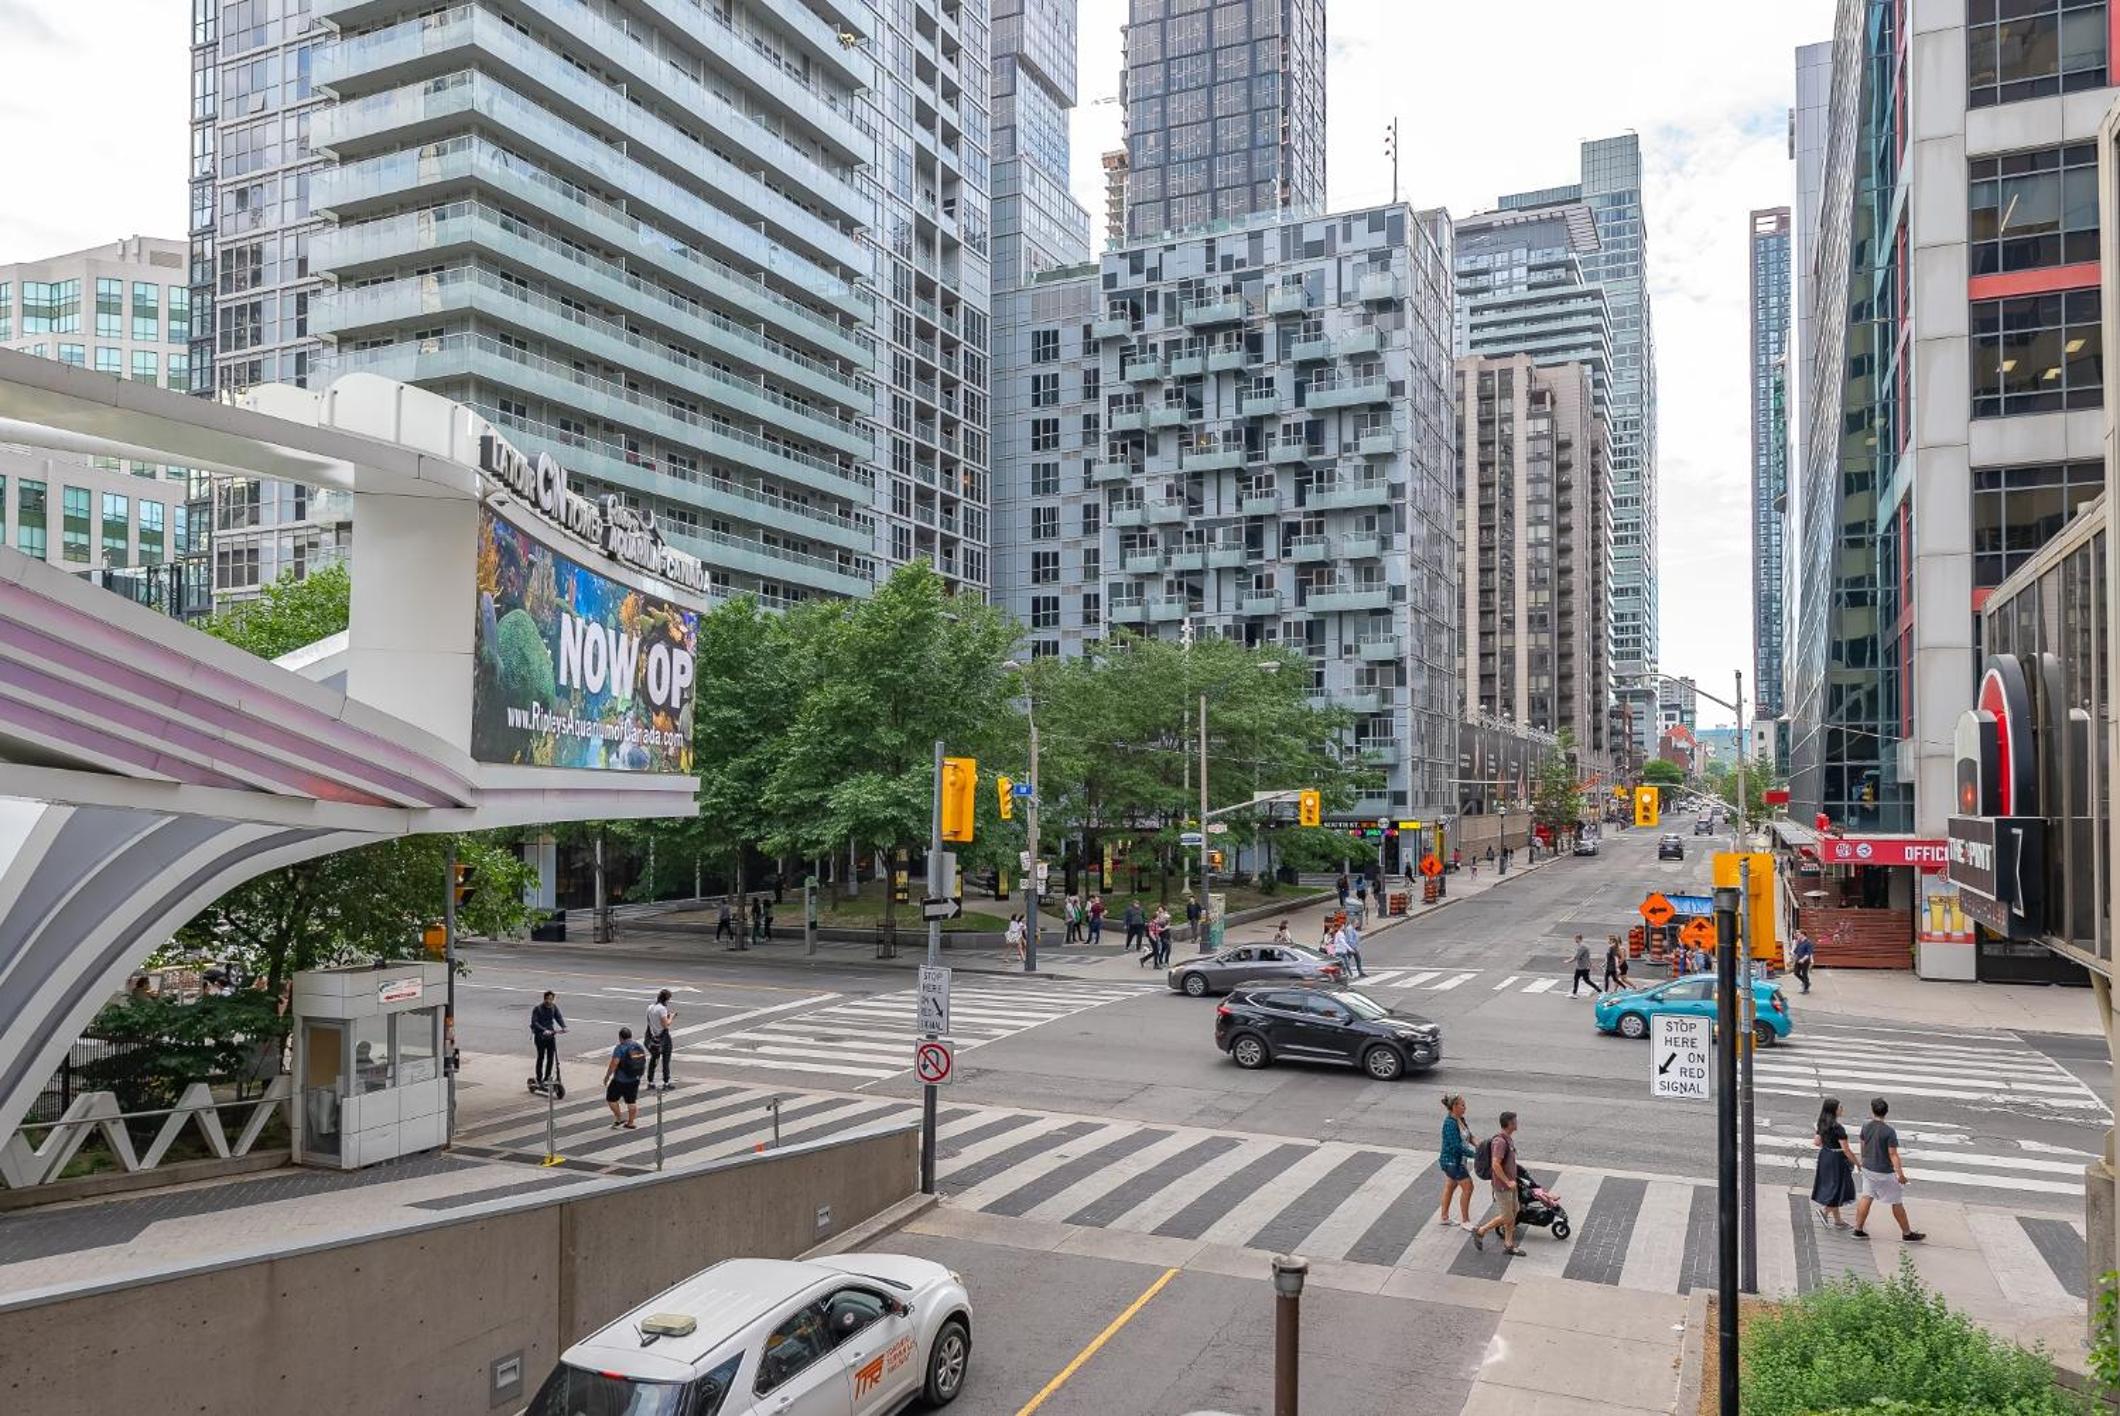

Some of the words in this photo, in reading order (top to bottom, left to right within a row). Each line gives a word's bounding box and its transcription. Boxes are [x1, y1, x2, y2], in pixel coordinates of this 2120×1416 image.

[537, 451, 568, 524] CN
[566, 496, 603, 544] TOWER
[608, 525, 661, 574] AQUARIUM
[667, 554, 711, 593] CANADA
[560, 612, 641, 699] NOW
[647, 642, 694, 709] OP
[1666, 1021, 1697, 1033] STOP
[1664, 1036, 1698, 1048] HERE
[1688, 1052, 1706, 1063] ON
[1679, 1067, 1705, 1079] RED
[1660, 1080, 1704, 1095] SIGNAL
